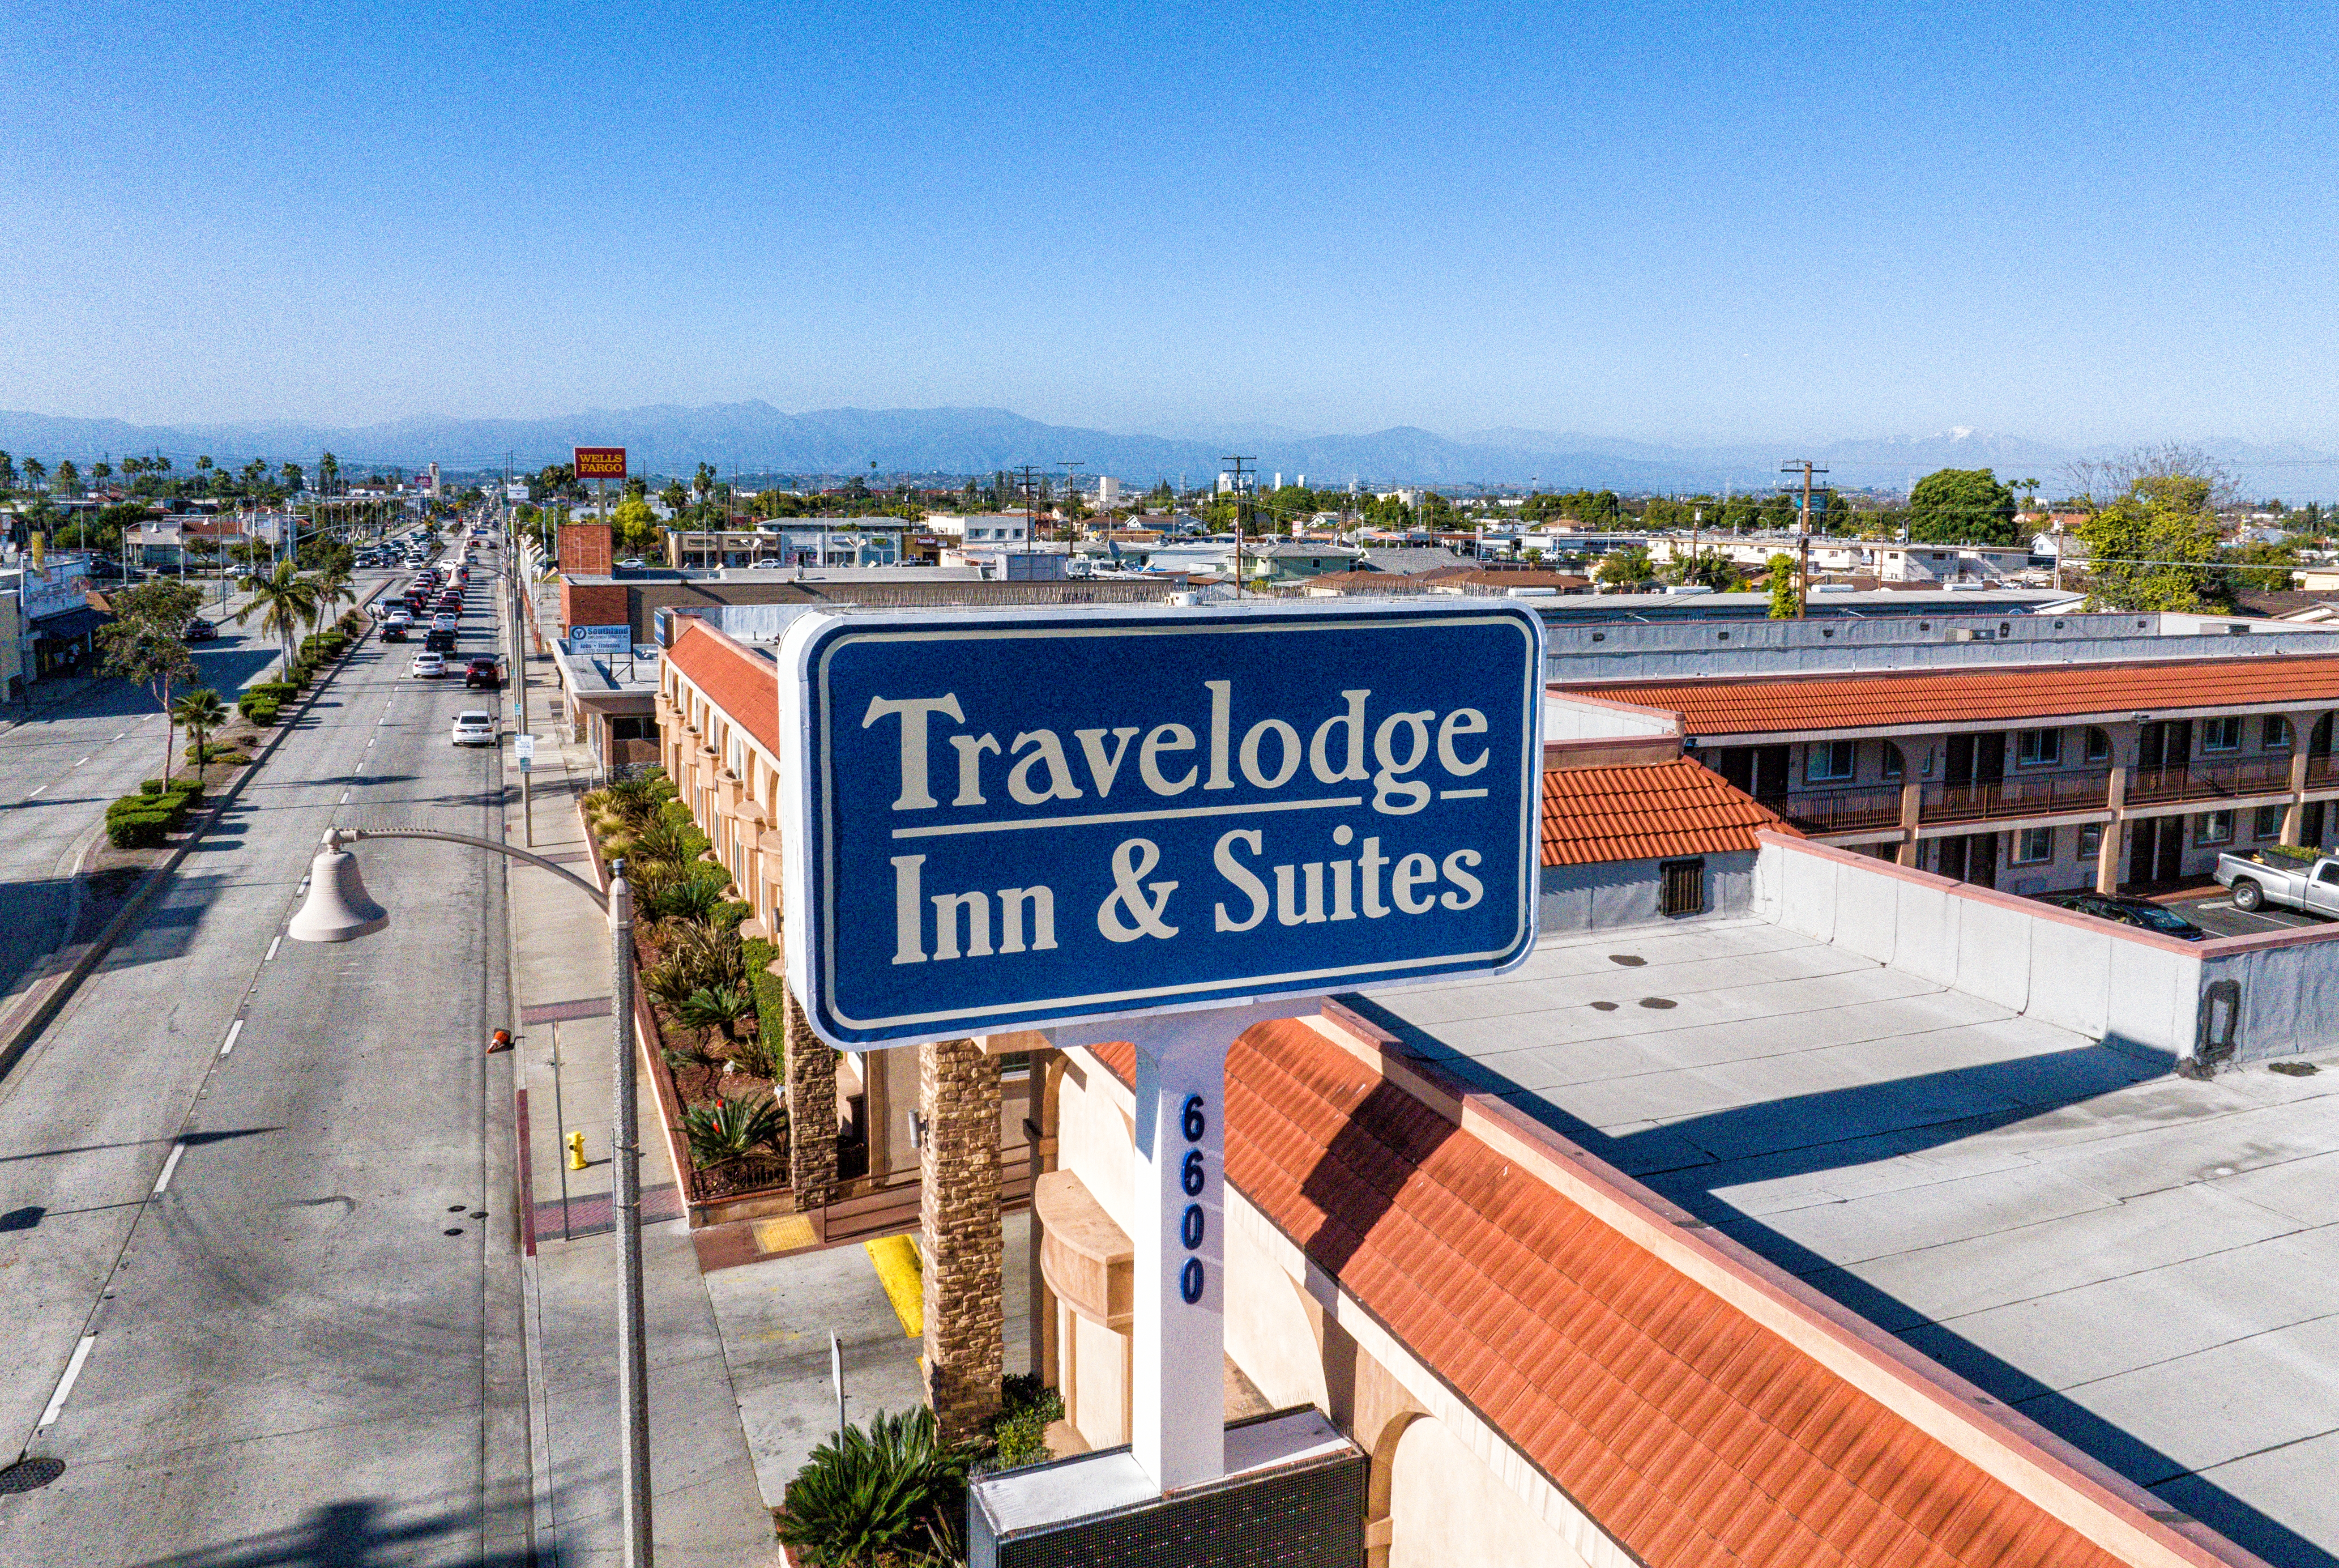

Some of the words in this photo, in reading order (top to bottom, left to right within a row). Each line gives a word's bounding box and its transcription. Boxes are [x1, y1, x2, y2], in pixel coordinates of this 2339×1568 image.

[579, 454, 622, 462] WELLS
[580, 464, 622, 472] FARGO
[862, 681, 1489, 815] Travelodge
[891, 855, 1058, 965] Inn
[1097, 839, 1179, 942] &
[1214, 824, 1483, 932] Suites
[1182, 1094, 1205, 1305] 6600
